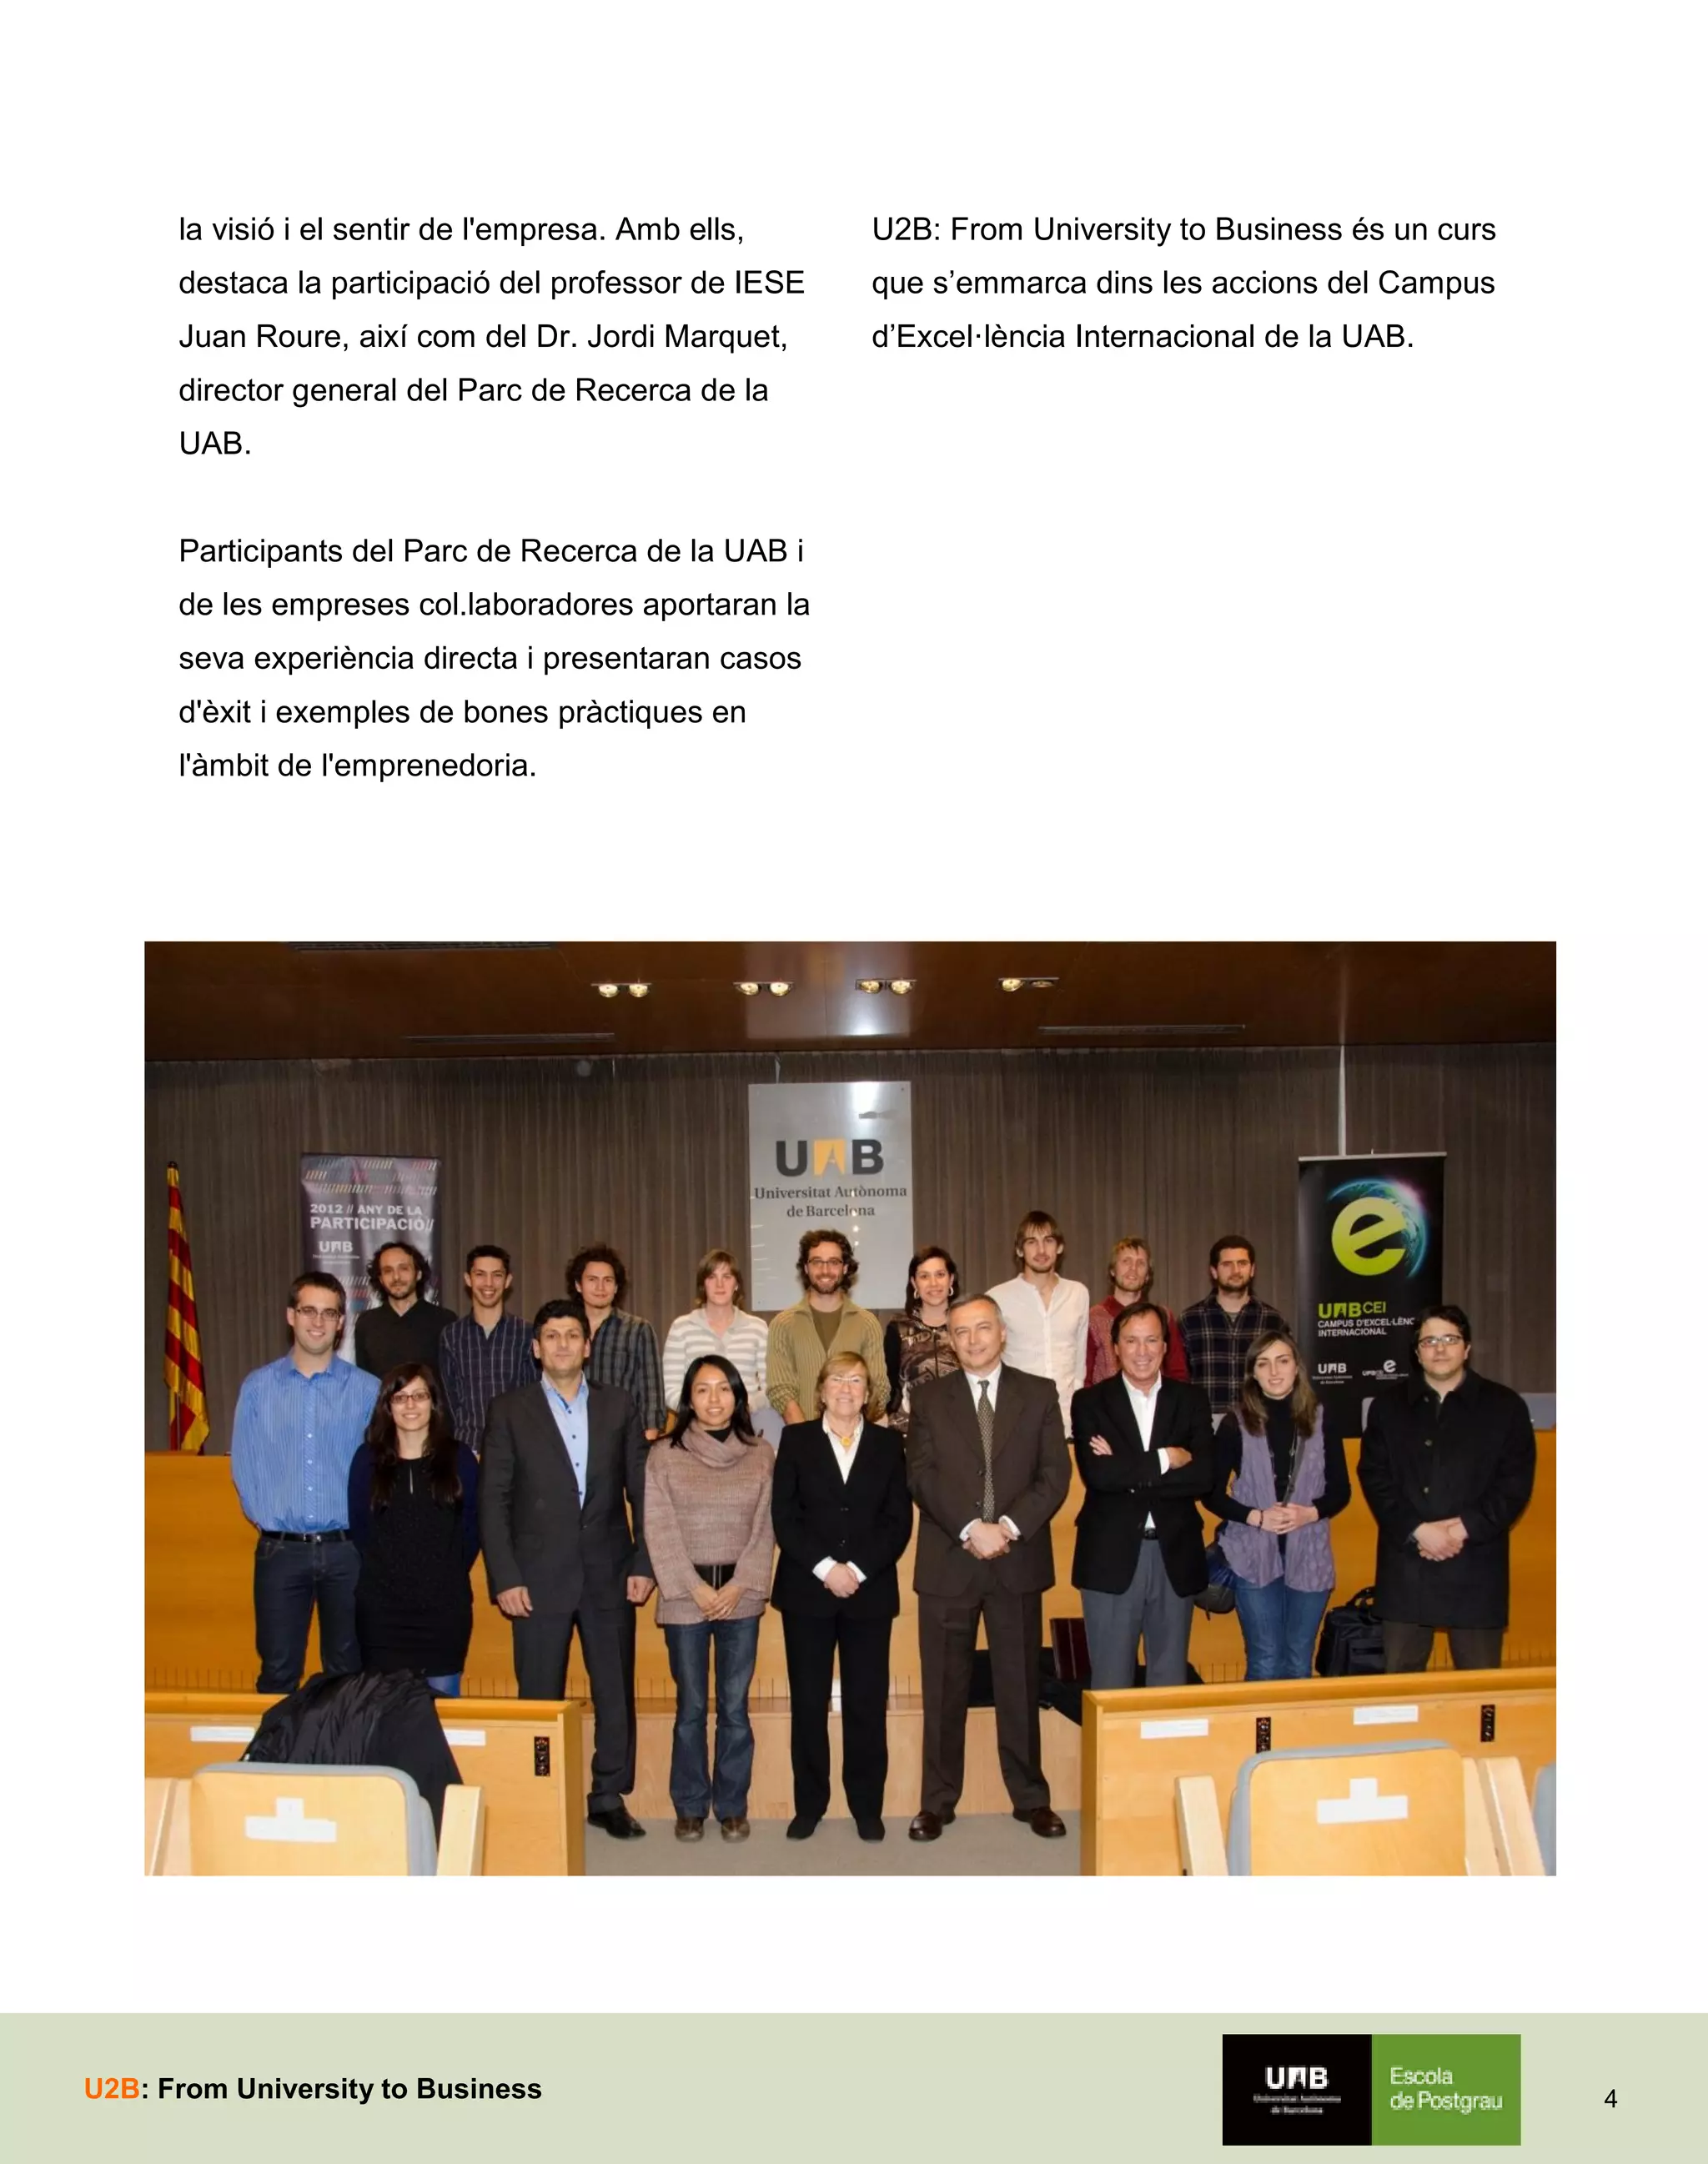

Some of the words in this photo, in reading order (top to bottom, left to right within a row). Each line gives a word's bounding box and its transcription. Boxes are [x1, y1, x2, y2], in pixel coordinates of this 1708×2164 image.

[180, 216, 202, 241] la
[212, 216, 274, 241] visió
[284, 216, 289, 241] i
[299, 216, 323, 241] el
[333, 216, 410, 241] sentir
[419, 216, 453, 241] de
[463, 216, 605, 247] l'empresa.
[615, 216, 681, 241] Amb
[690, 216, 743, 245] ells,
[873, 216, 940, 241] U2B:
[952, 216, 1022, 241] From
[1034, 216, 1172, 248] University
[1179, 217, 1206, 241] to
[1216, 216, 1343, 241] Business
[1352, 216, 1384, 241] és
[1394, 222, 1428, 241] un
[1438, 222, 1496, 241] curs
[179, 269, 288, 294] destaca
[299, 269, 321, 294] la
[332, 269, 490, 300] participació
[500, 269, 540, 294] del
[551, 269, 683, 300] professor
[691, 269, 725, 294] de
[736, 269, 805, 294] IESE
[872, 275, 924, 300] que
[933, 269, 1087, 294] s’emmarca
[1097, 269, 1153, 294] dins
[1163, 269, 1203, 294] les
[1212, 269, 1318, 294] accions
[1328, 269, 1368, 294] del
[1379, 269, 1495, 300] Campus
[178, 324, 246, 349] Juan
[257, 324, 349, 352] Roure,
[359, 324, 409, 349] així
[417, 329, 475, 349] com
[485, 324, 526, 349] del
[538, 324, 577, 348] Dr.
[587, 324, 654, 349] Jordi
[666, 324, 786, 354] Marquet,
[872, 324, 1065, 349] d’Excel·lència
[1077, 324, 1254, 349] Internacional
[1264, 324, 1299, 349] de
[1309, 324, 1332, 349] la
[1343, 324, 1413, 348] UAB.
[178, 377, 284, 402] director
[292, 377, 396, 408] general
[407, 377, 447, 402] del
[459, 377, 522, 402] Parc
[531, 377, 565, 402] de
[576, 377, 691, 402] Recerca
[701, 377, 736, 402] de
[746, 377, 768, 402] la
[180, 430, 250, 455] UAB.
[180, 538, 343, 569] Participants
[352, 538, 393, 563] del
[404, 538, 468, 563] Parc
[476, 538, 511, 563] de
[521, 538, 637, 563] Recerca
[647, 538, 681, 563] de
[691, 538, 714, 563] la
[725, 538, 787, 563] UAB
[798, 538, 803, 562] i
[178, 591, 214, 616] de
[224, 591, 262, 616] les
[272, 597, 409, 622] empreses
[419, 591, 634, 616] col.laboradores
[643, 592, 776, 622] aportaran
[787, 591, 810, 616] la
[178, 651, 244, 670] seva
[254, 645, 414, 675] experiència
[424, 645, 518, 670] directa
[528, 645, 533, 670] i
[544, 646, 710, 675] presentaran
[720, 651, 801, 670] casos
[178, 699, 252, 724] d'èxit
[261, 699, 266, 723] i
[276, 699, 410, 730] exemples
[419, 699, 454, 724] de
[465, 699, 549, 724] bones
[559, 699, 703, 730] pràctiques
[712, 705, 746, 724] en
[180, 752, 269, 777] l'àmbit
[278, 752, 312, 777] de
[323, 752, 535, 783] l'emprenedoria.
[776, 1137, 884, 1177] UAB
[754, 1186, 831, 1199] Universitat
[834, 1184, 907, 1198] Autònoma
[310, 1203, 344, 1214] 2012
[357, 1204, 384, 1215] ANY
[387, 1205, 404, 1215] DE
[407, 1206, 423, 1216] LA
[786, 1204, 803, 1218] de
[806, 1203, 875, 1218] Barcelona
[319, 1240, 354, 1253] UAB
[1318, 1319, 1354, 1328] CAMPUS
[1318, 1327, 1387, 1337] INTERNACIONAL
[1318, 1362, 1347, 1374] UAB
[1265, 2066, 1329, 2090] UAB
[1390, 2066, 1453, 2086] Escola
[84, 2077, 148, 2100] U2B:
[158, 2077, 228, 2100] From
[238, 2077, 374, 2106] University
[380, 2077, 408, 2100] to
[417, 2077, 542, 2100] Business
[1390, 2091, 1414, 2110] de
[1418, 2090, 1503, 2115] Postgrau
[1604, 2088, 1618, 2109] 4
